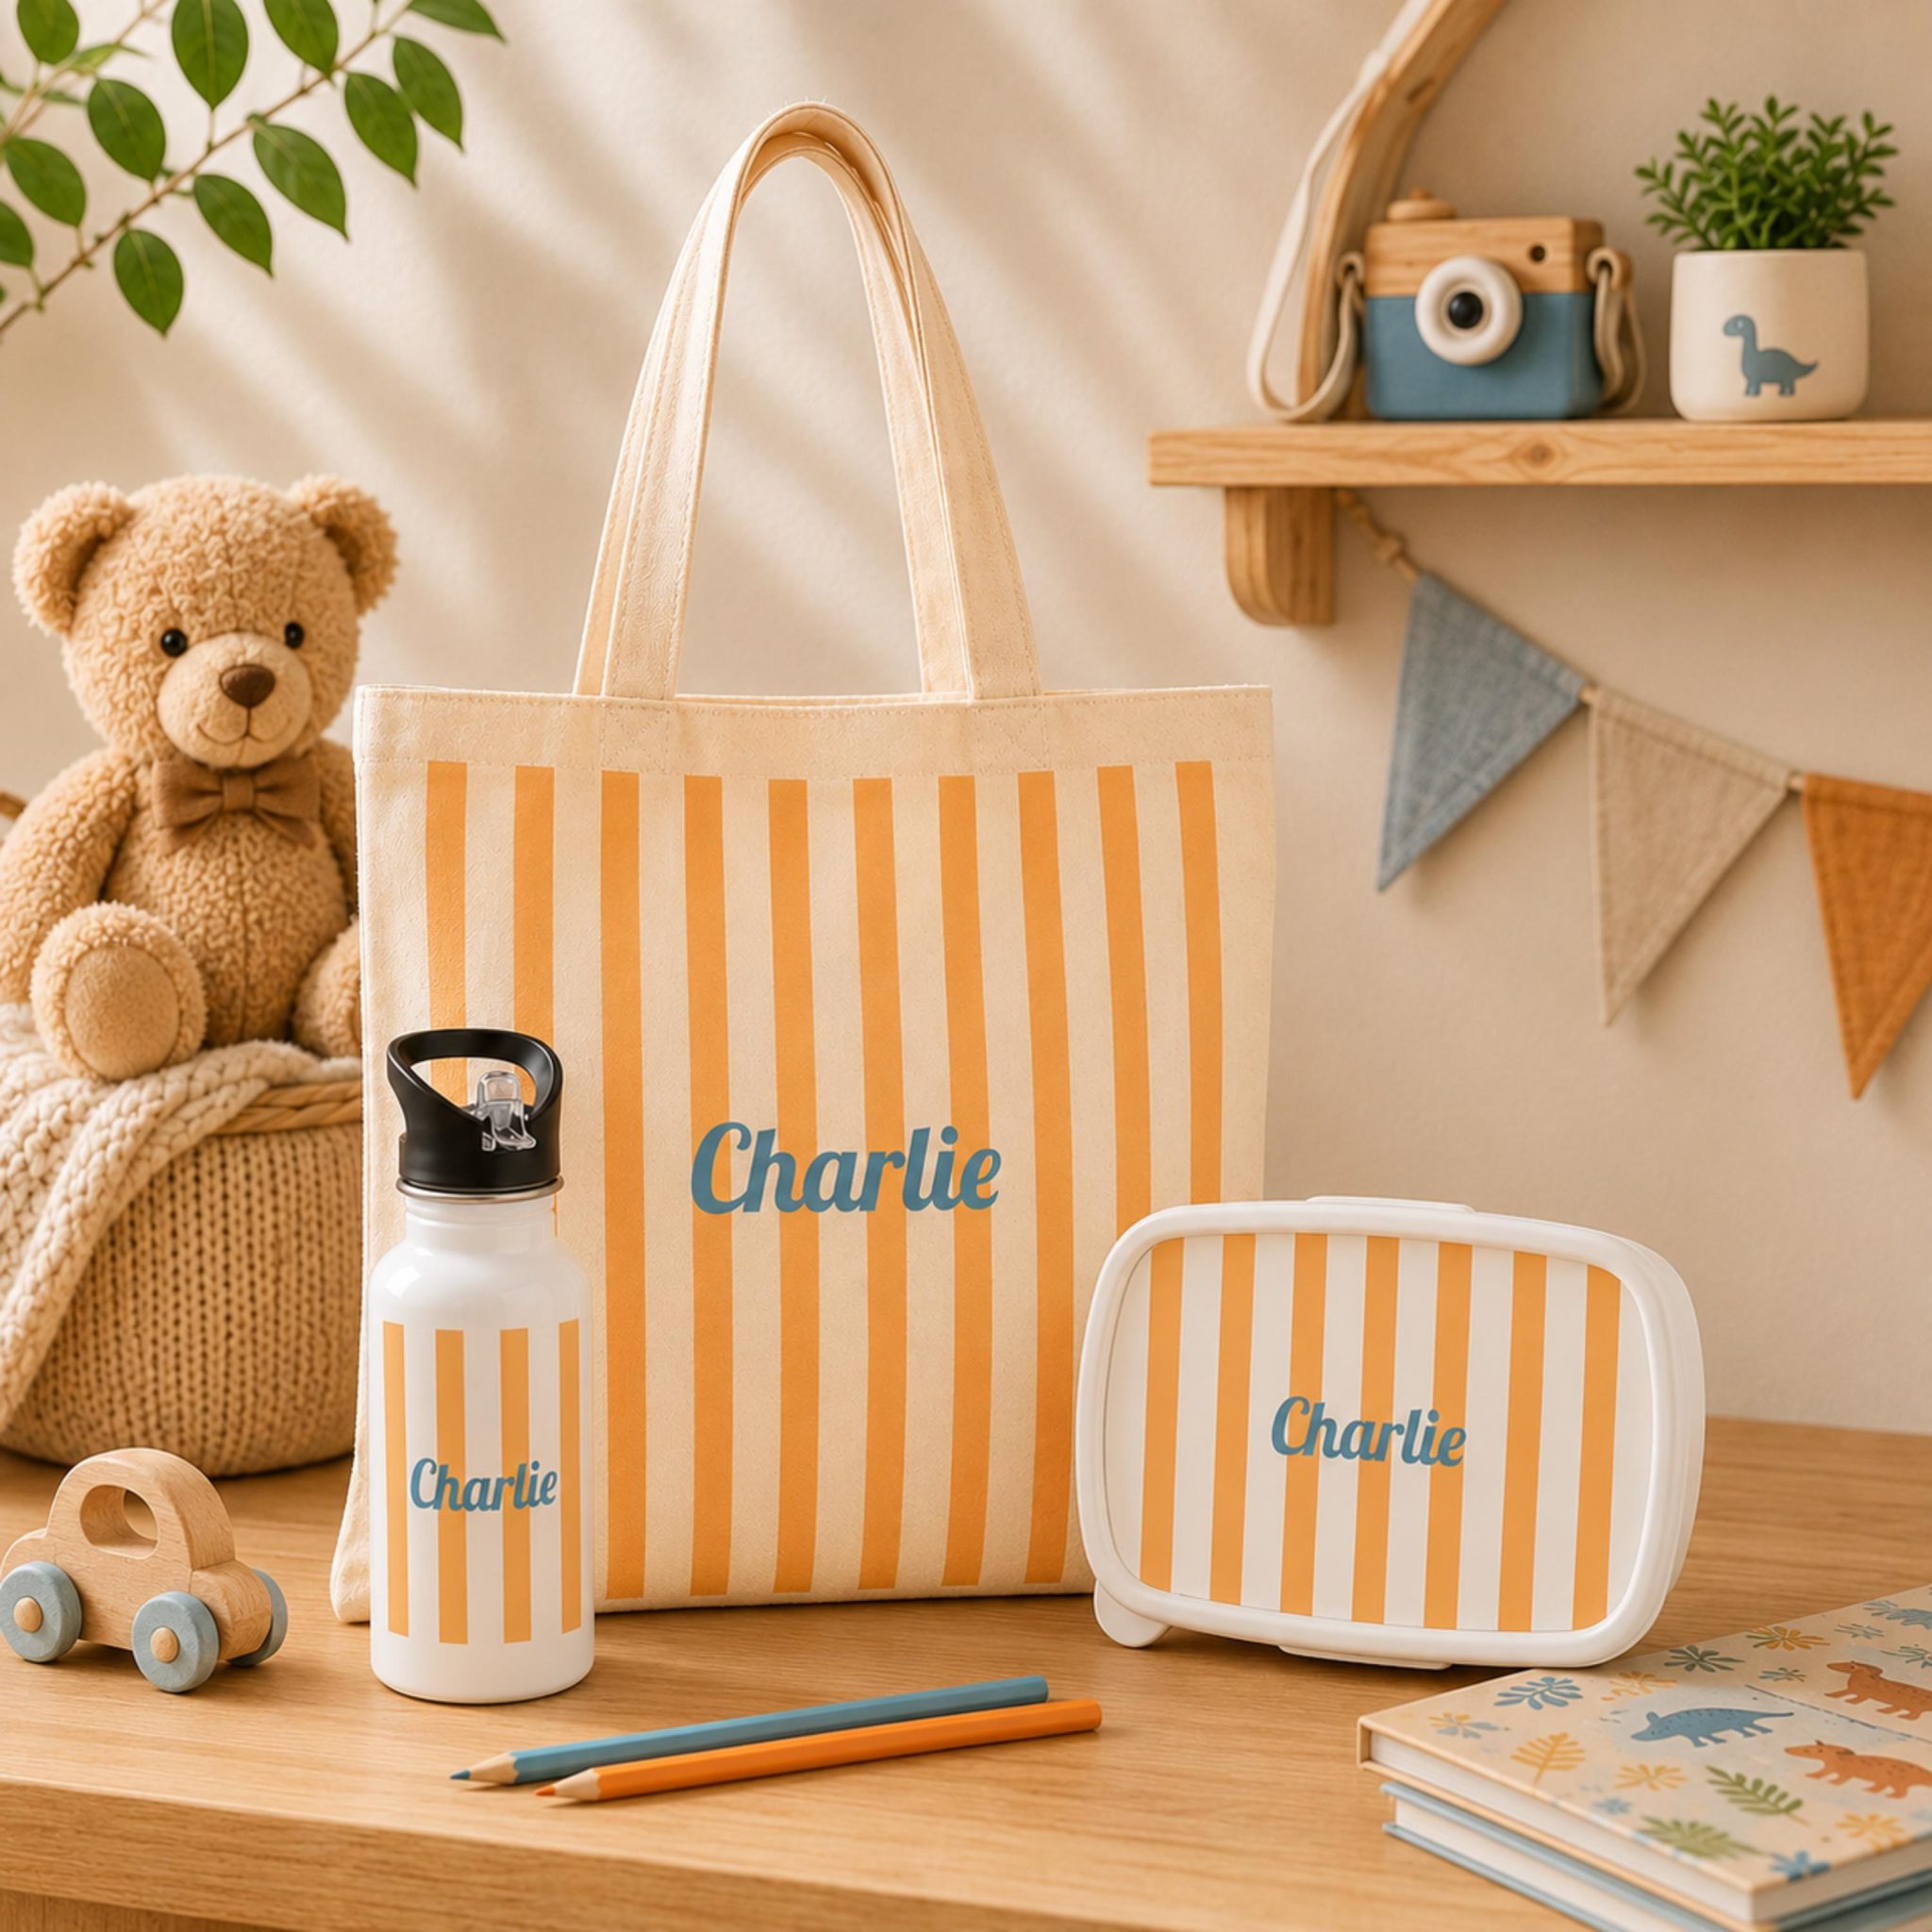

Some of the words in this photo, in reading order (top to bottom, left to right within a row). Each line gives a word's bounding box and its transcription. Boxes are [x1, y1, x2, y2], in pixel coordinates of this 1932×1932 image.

[691, 1122, 1001, 1214] Charlie
[1272, 1395, 1467, 1467] Charlie
[410, 1457, 558, 1511] Charlie
